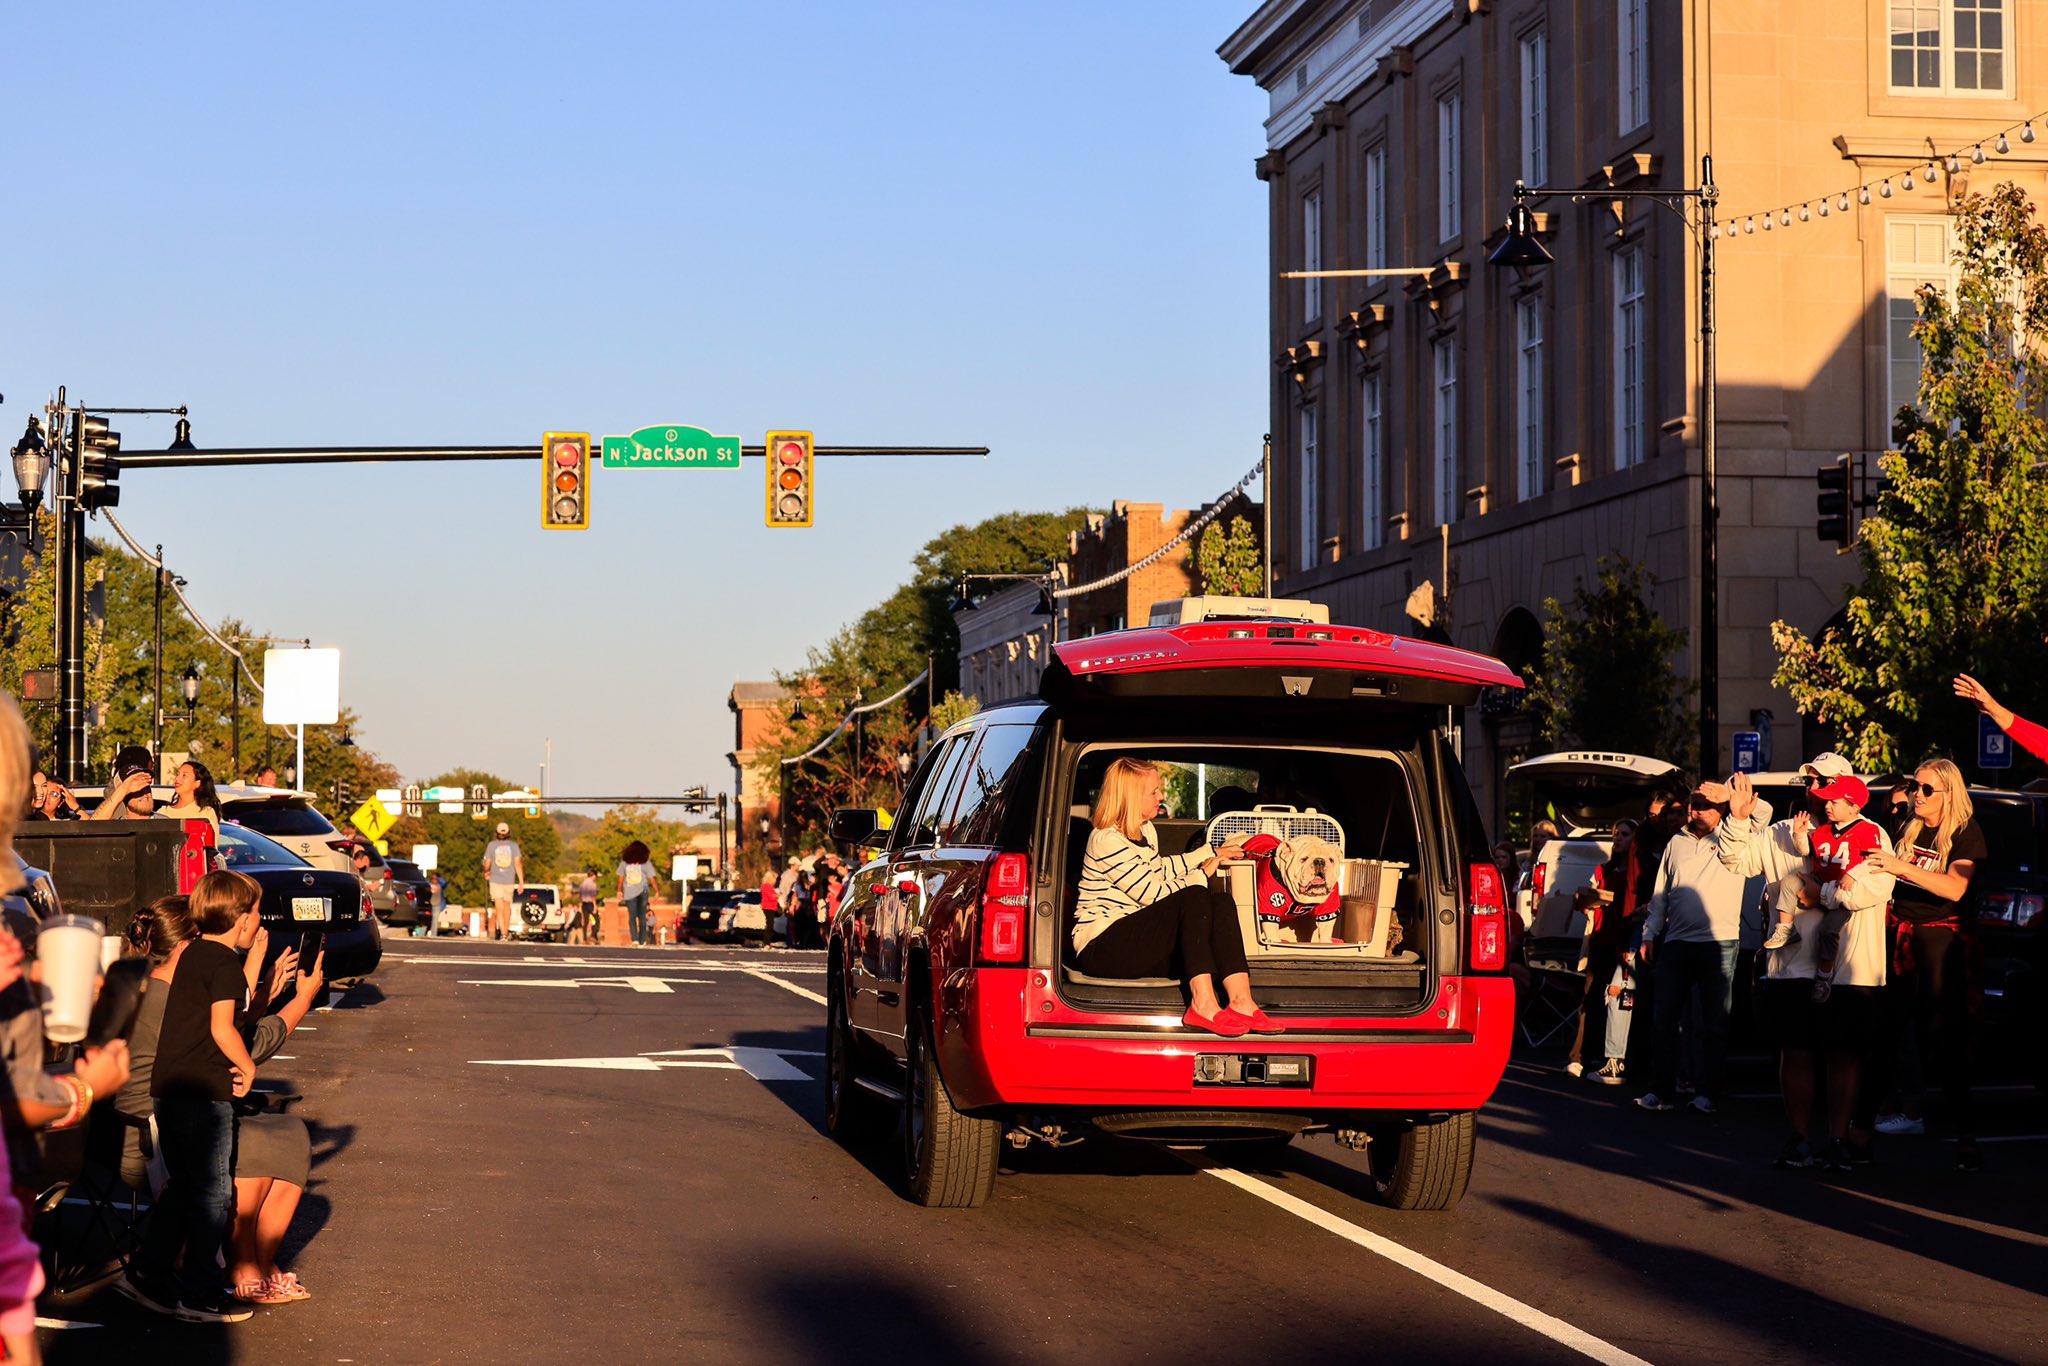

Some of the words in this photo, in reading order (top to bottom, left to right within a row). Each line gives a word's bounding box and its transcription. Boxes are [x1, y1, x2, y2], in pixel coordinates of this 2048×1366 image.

[610, 447, 621, 461] N
[630, 444, 708, 461] Jackson
[716, 447, 733, 461] St
[1817, 841, 1850, 870] 34
[1269, 892, 1286, 908] SEC
